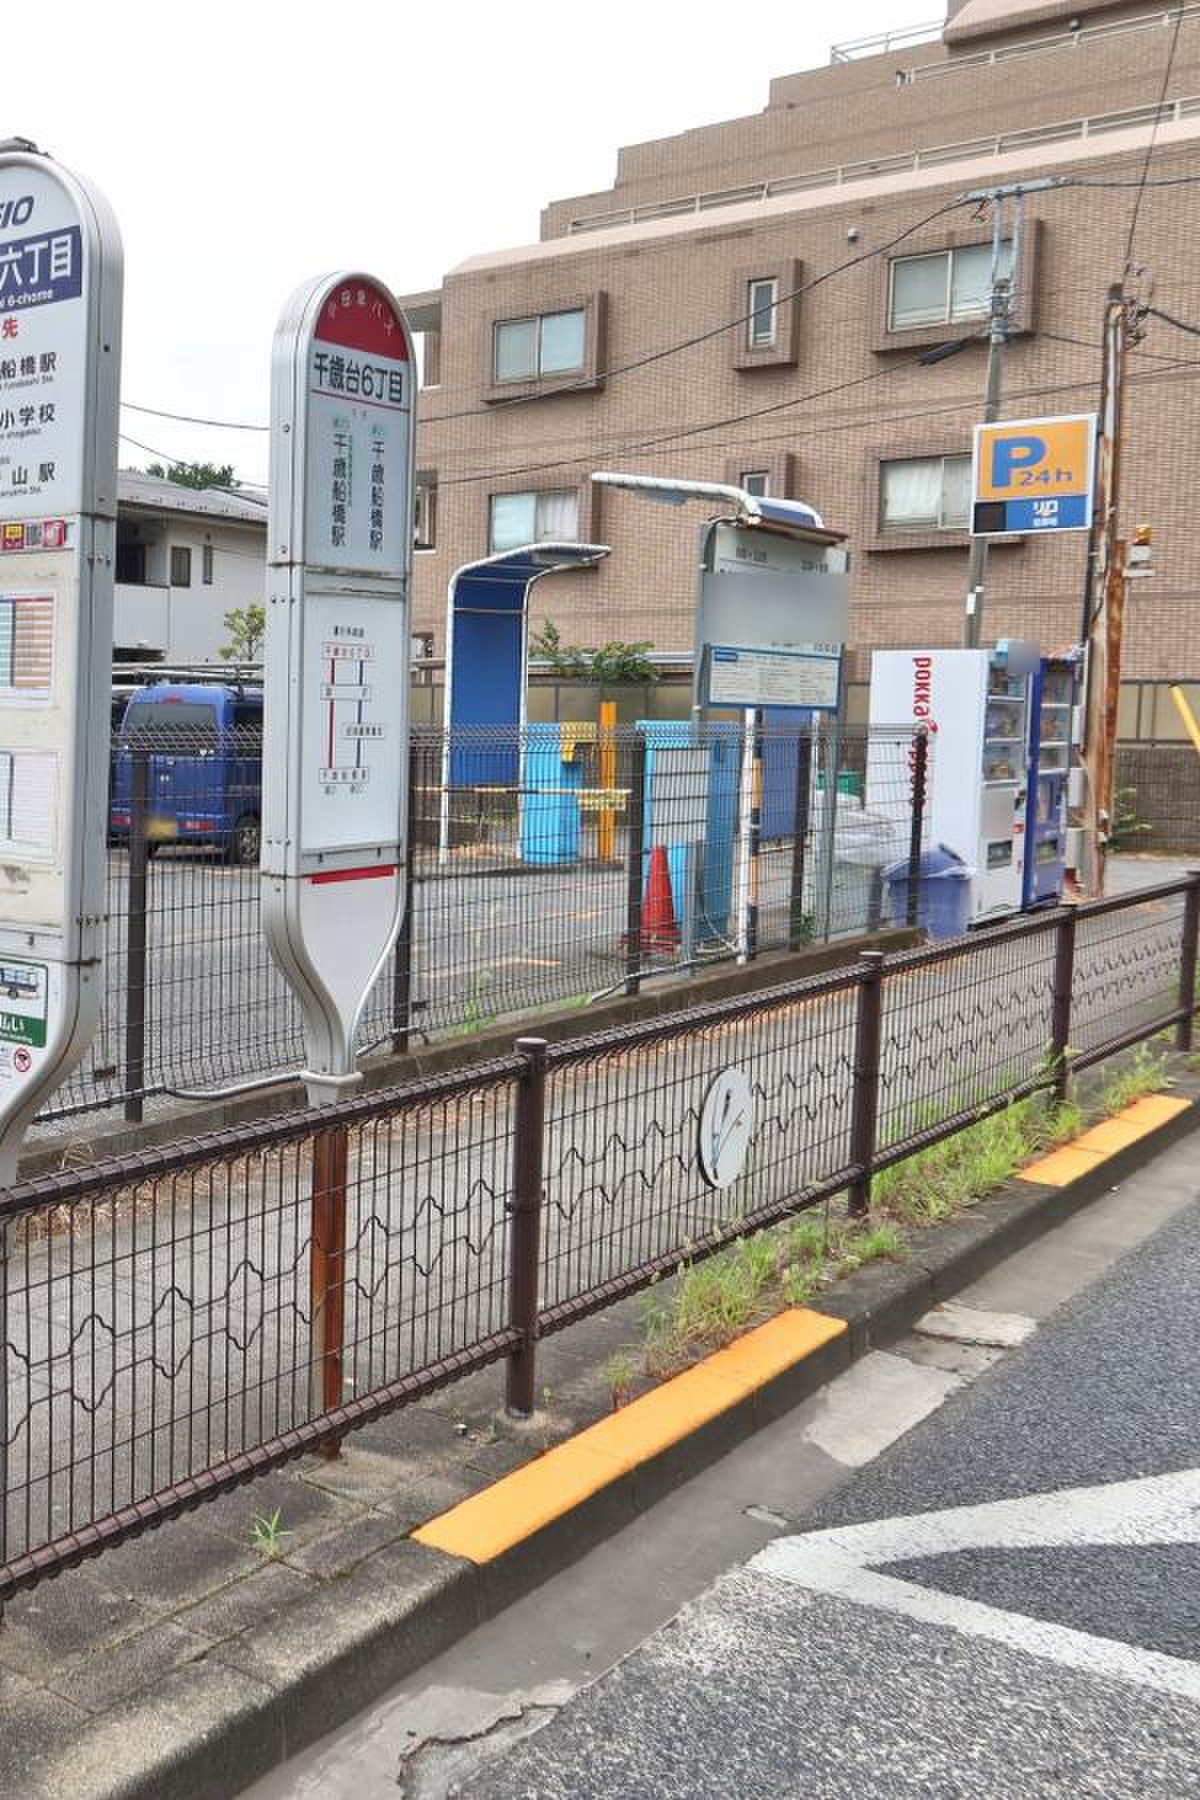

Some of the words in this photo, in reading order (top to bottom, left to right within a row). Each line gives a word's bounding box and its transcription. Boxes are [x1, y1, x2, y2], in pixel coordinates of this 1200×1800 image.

[313, 352, 403, 402] 千歳台6丁目
[992, 437, 1047, 488] P
